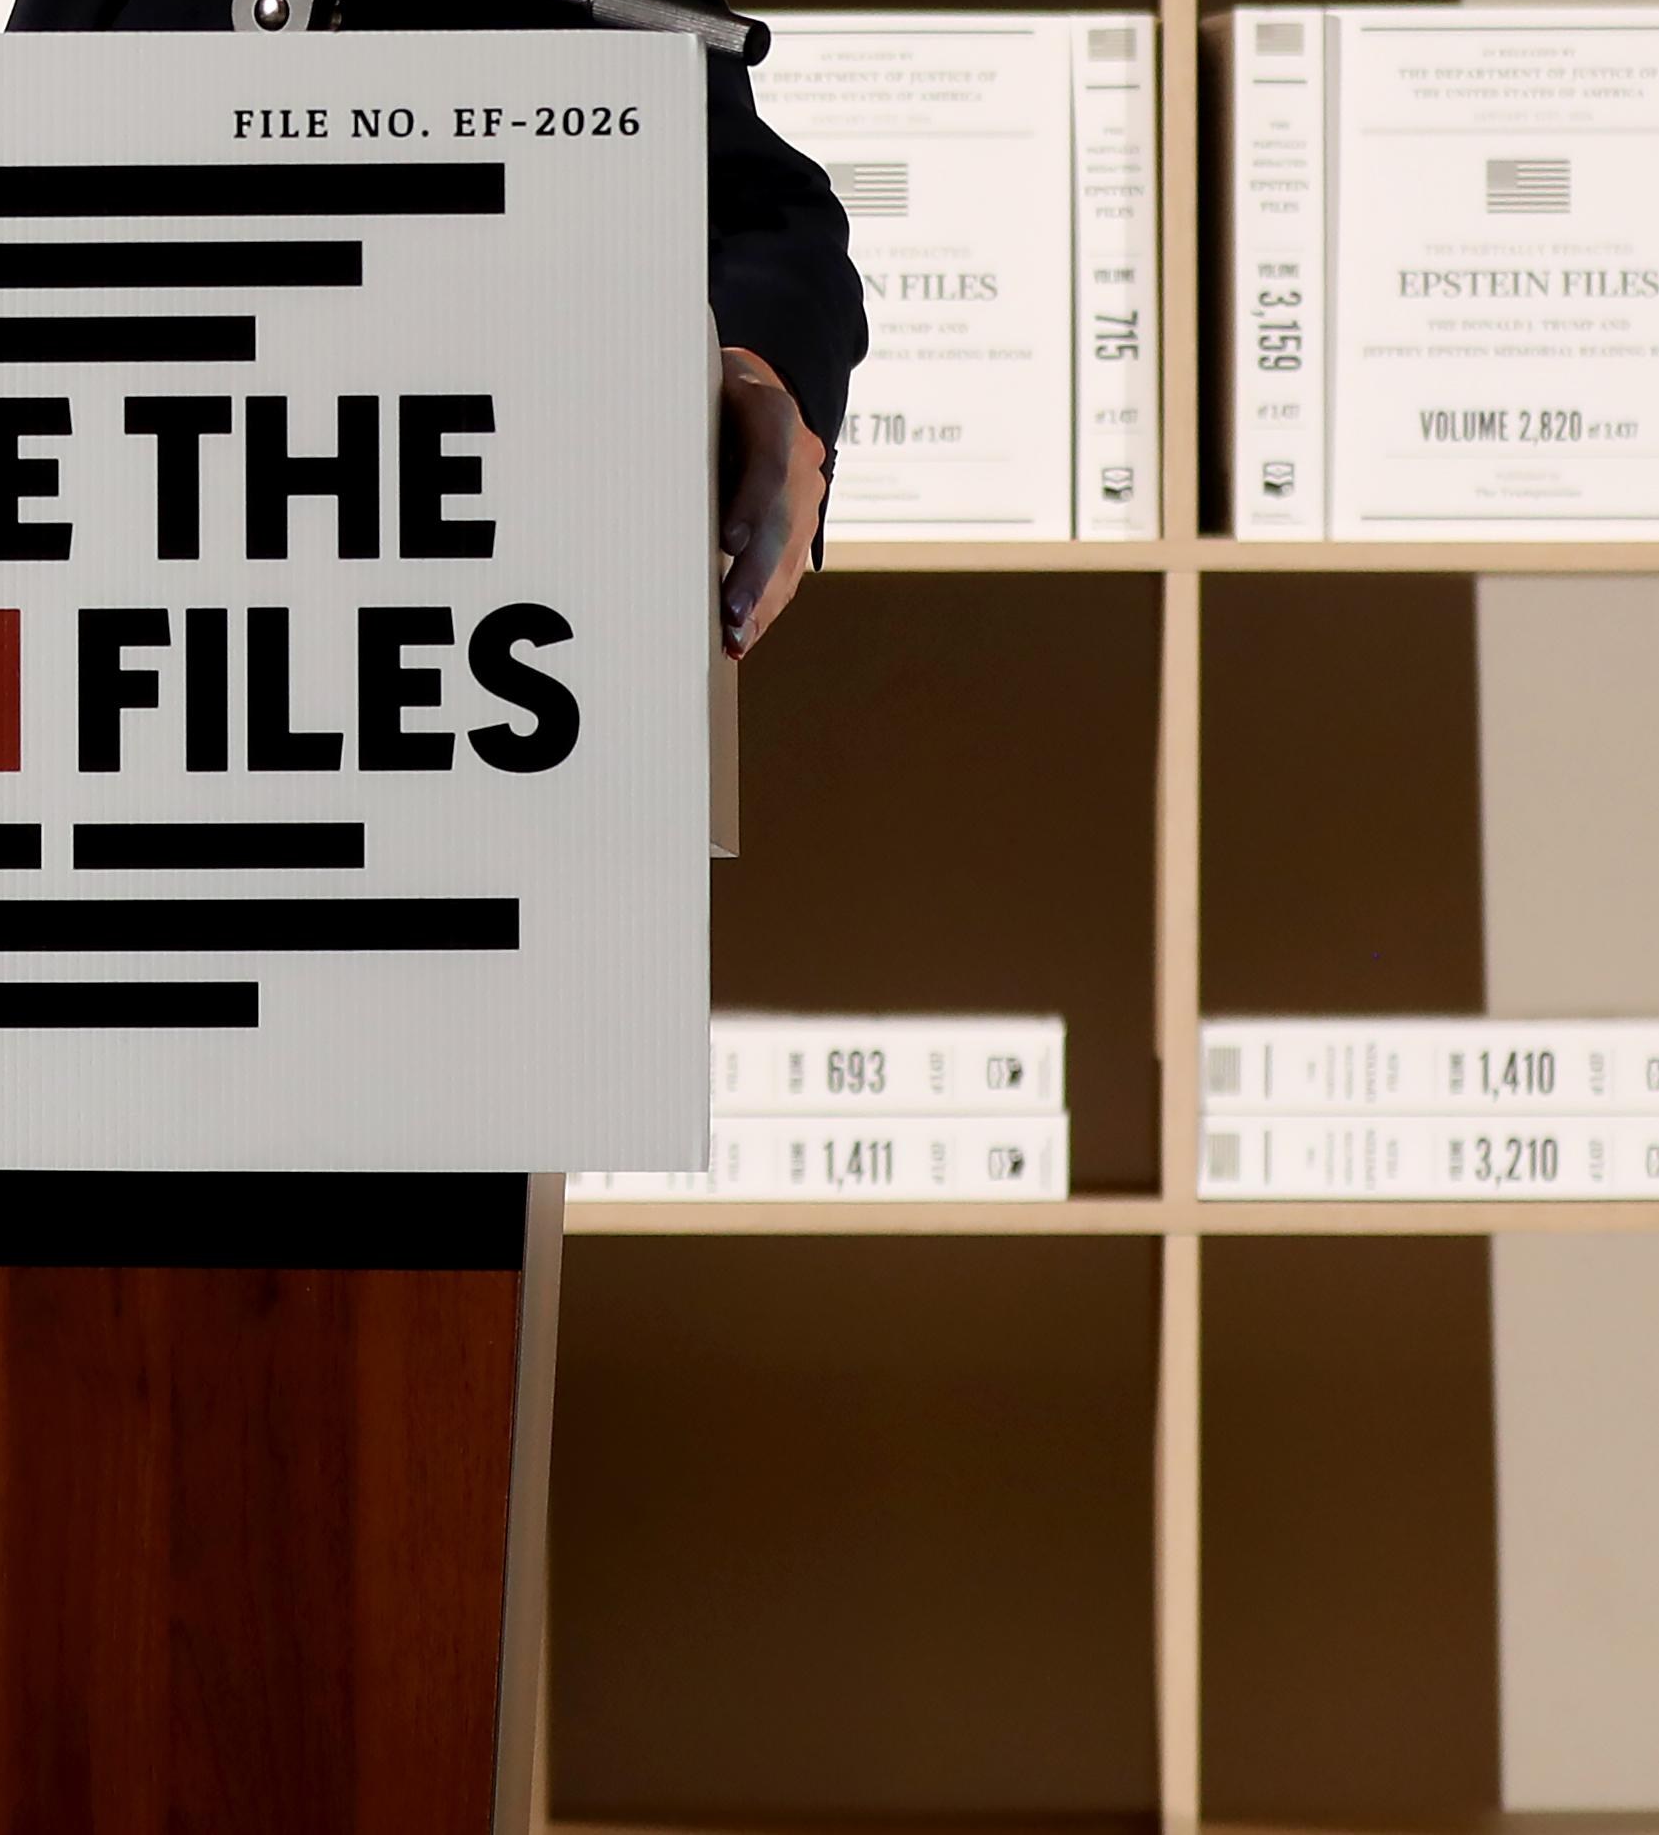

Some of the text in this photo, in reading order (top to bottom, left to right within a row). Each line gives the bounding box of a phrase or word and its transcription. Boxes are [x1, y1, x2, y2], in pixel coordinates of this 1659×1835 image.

[234, 107, 639, 138] FILE NO. EF-2026
[900, 273, 998, 300] FILES
[1398, 269, 1659, 297] EPSTEIN FILES
[1095, 309, 1140, 360] 715
[1252, 291, 1302, 371] 3,159
[870, 413, 906, 445] 710
[1420, 410, 1508, 441] VOLUME
[1519, 409, 1582, 443] 2,820
[124, 394, 496, 560] THE
[78, 603, 580, 773] FILES
[827, 1048, 885, 1093] 693
[1479, 1050, 1555, 1097] 1,410
[824, 1140, 892, 1186] 1,411
[1475, 1136, 1558, 1185] 3,210
